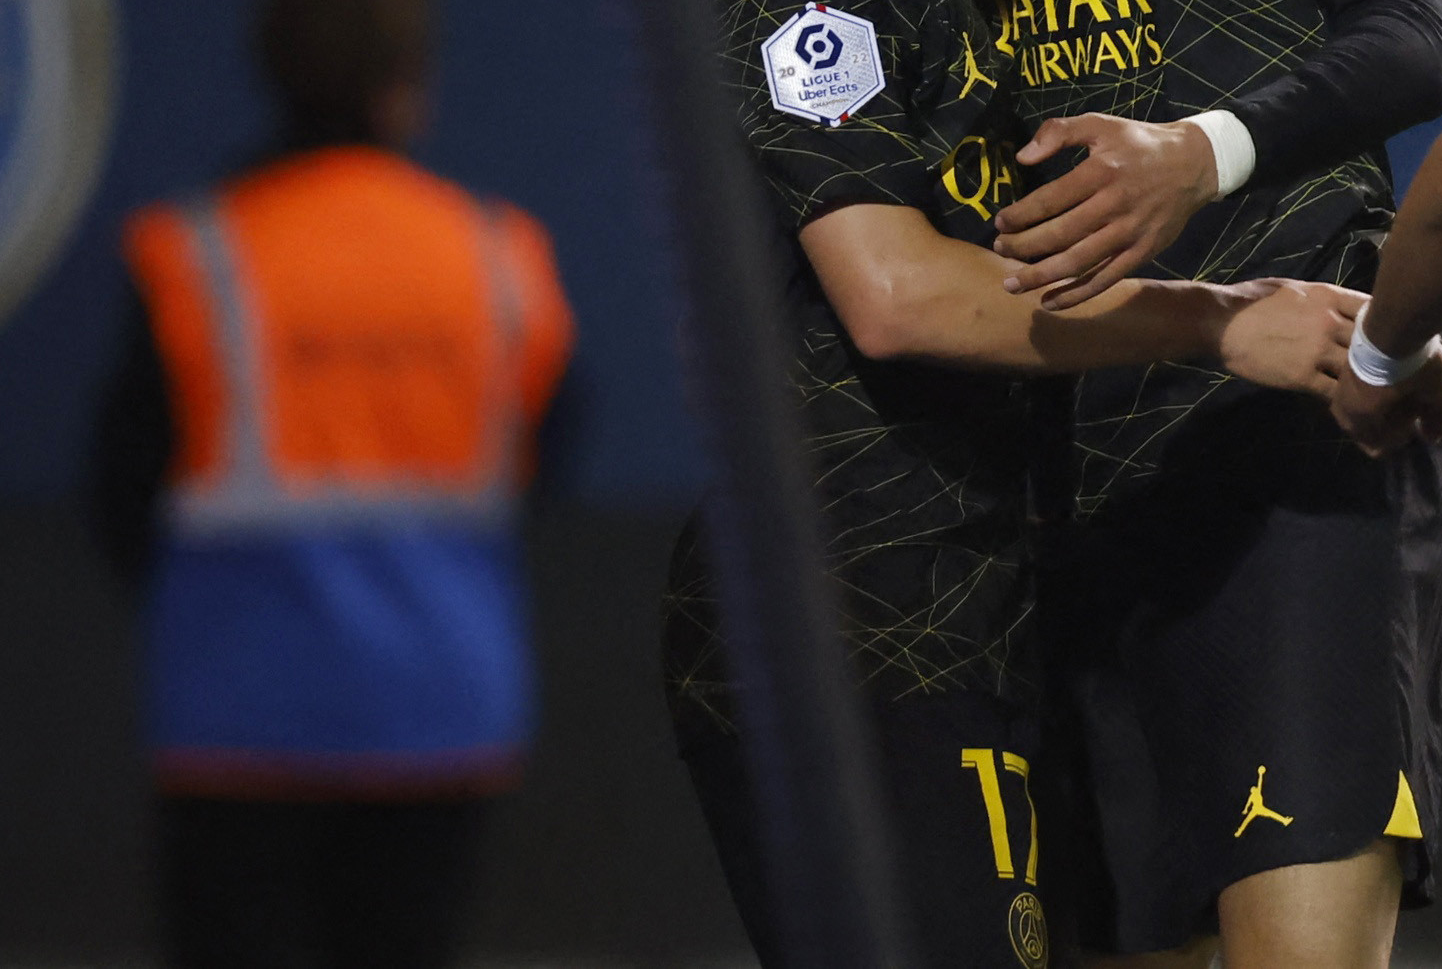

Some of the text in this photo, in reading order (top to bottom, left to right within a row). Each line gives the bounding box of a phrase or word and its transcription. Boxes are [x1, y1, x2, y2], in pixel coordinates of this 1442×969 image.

[852, 53, 868, 64] 22
[1020, 24, 1163, 87] AIRWAYS
[779, 66, 796, 79] 20
[802, 70, 850, 88] LIGUE 1
[798, 82, 858, 102] Uber Eats
[961, 748, 1039, 887] 17
